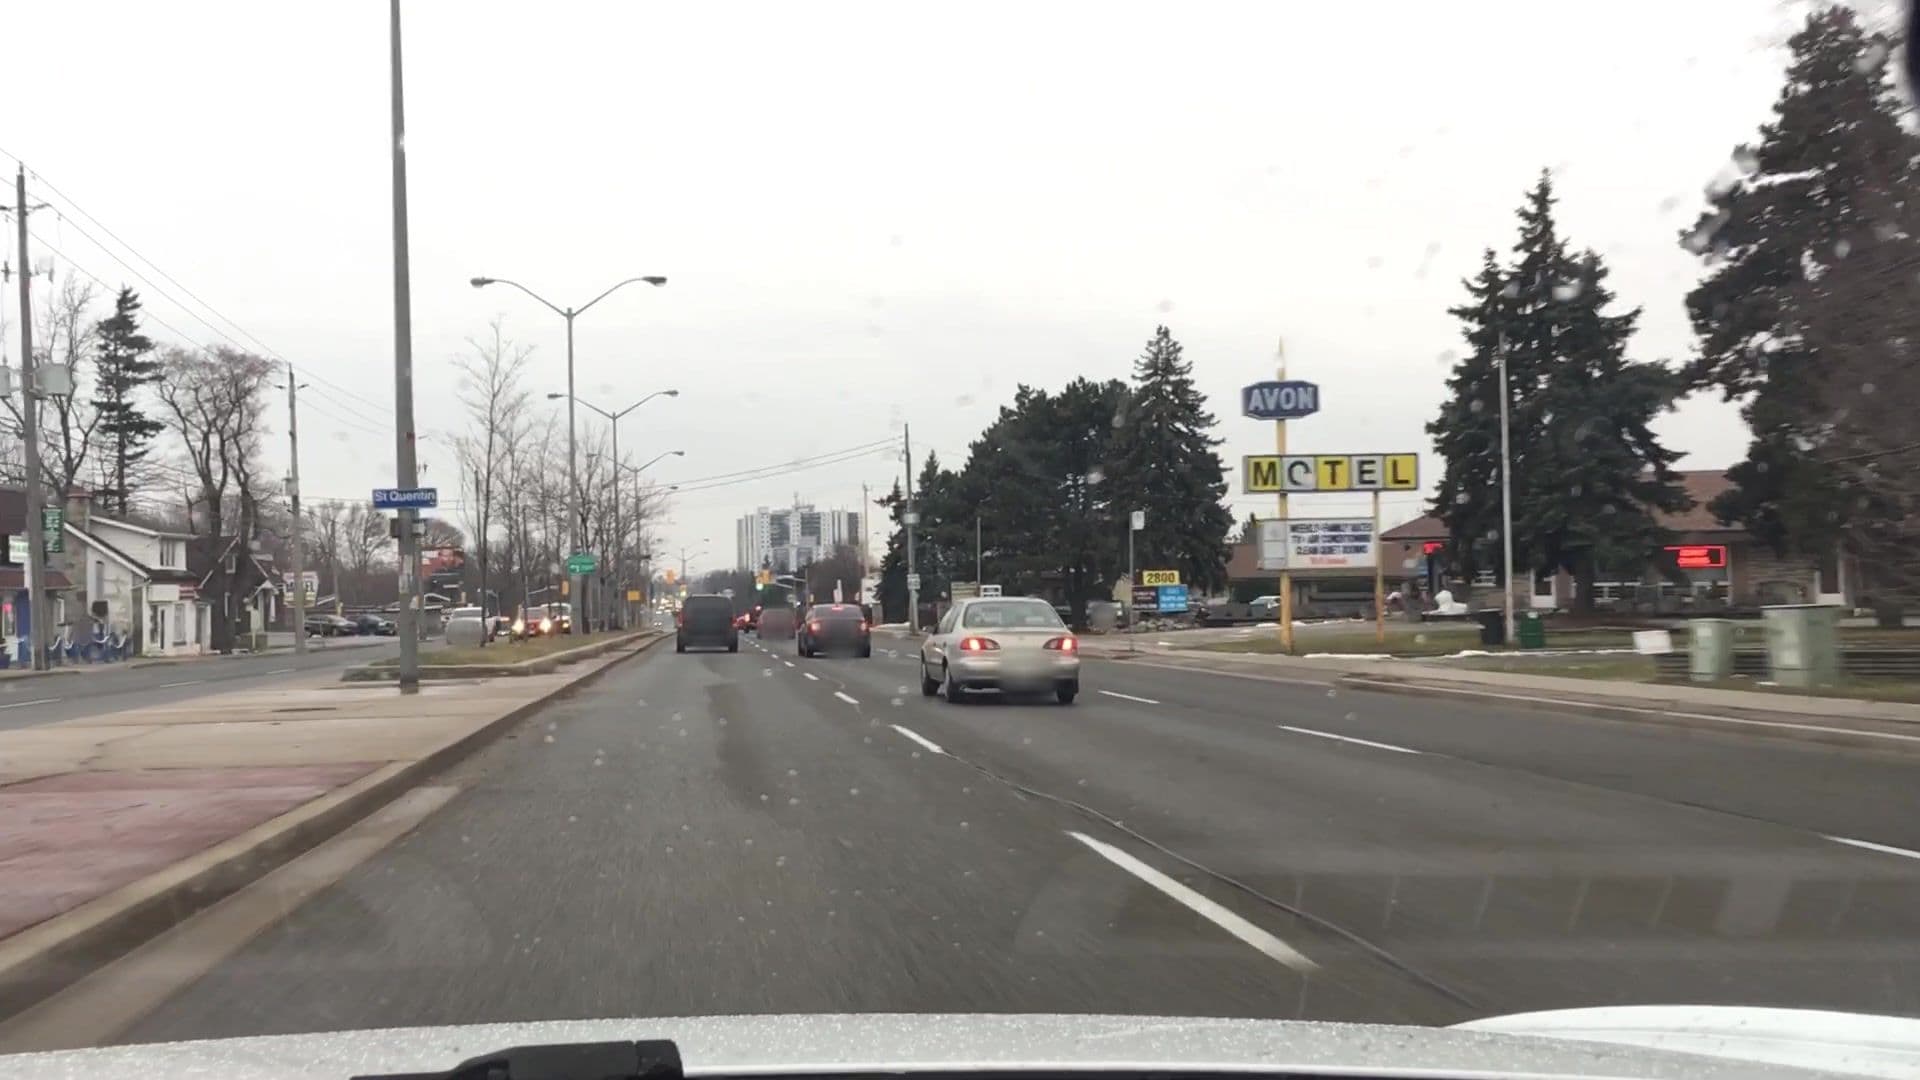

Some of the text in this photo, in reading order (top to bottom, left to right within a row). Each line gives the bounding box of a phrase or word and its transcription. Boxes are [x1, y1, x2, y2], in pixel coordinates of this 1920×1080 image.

[1248, 387, 1314, 411] AVON
[1252, 459, 1411, 487] MOTEL
[375, 491, 435, 502] St Quentin
[1147, 572, 1176, 584] 2800
